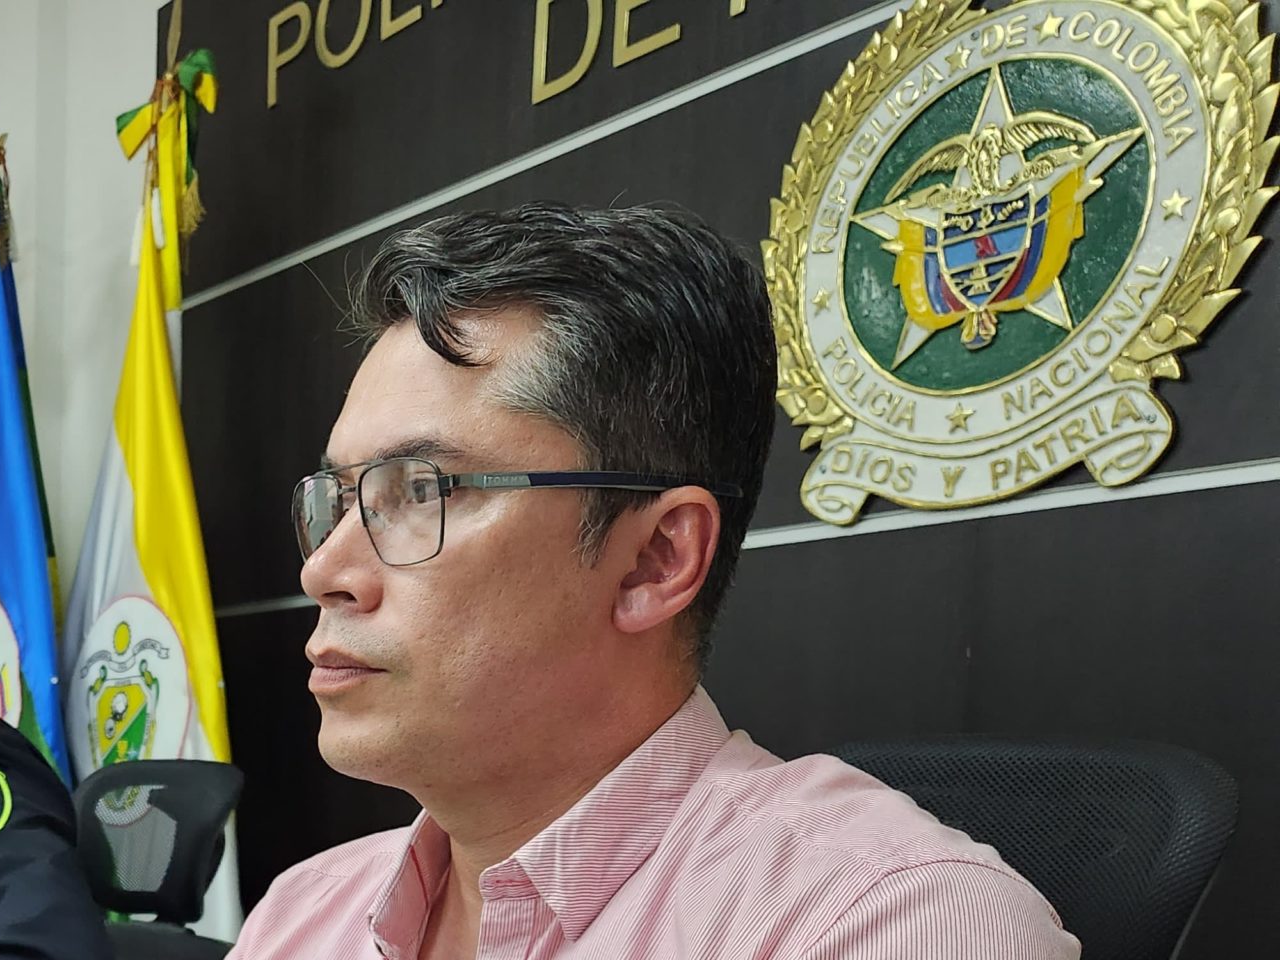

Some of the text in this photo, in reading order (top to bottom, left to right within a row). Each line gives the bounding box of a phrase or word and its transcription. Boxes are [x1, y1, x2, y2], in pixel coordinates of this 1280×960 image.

[267, 0, 444, 109] POL
[811, 10, 1197, 254] REPUBLICA DE COLOMBIA
[822, 255, 1170, 432] POLICIA NACIONAL
[831, 392, 1142, 498] DIOS Y PATRIA
